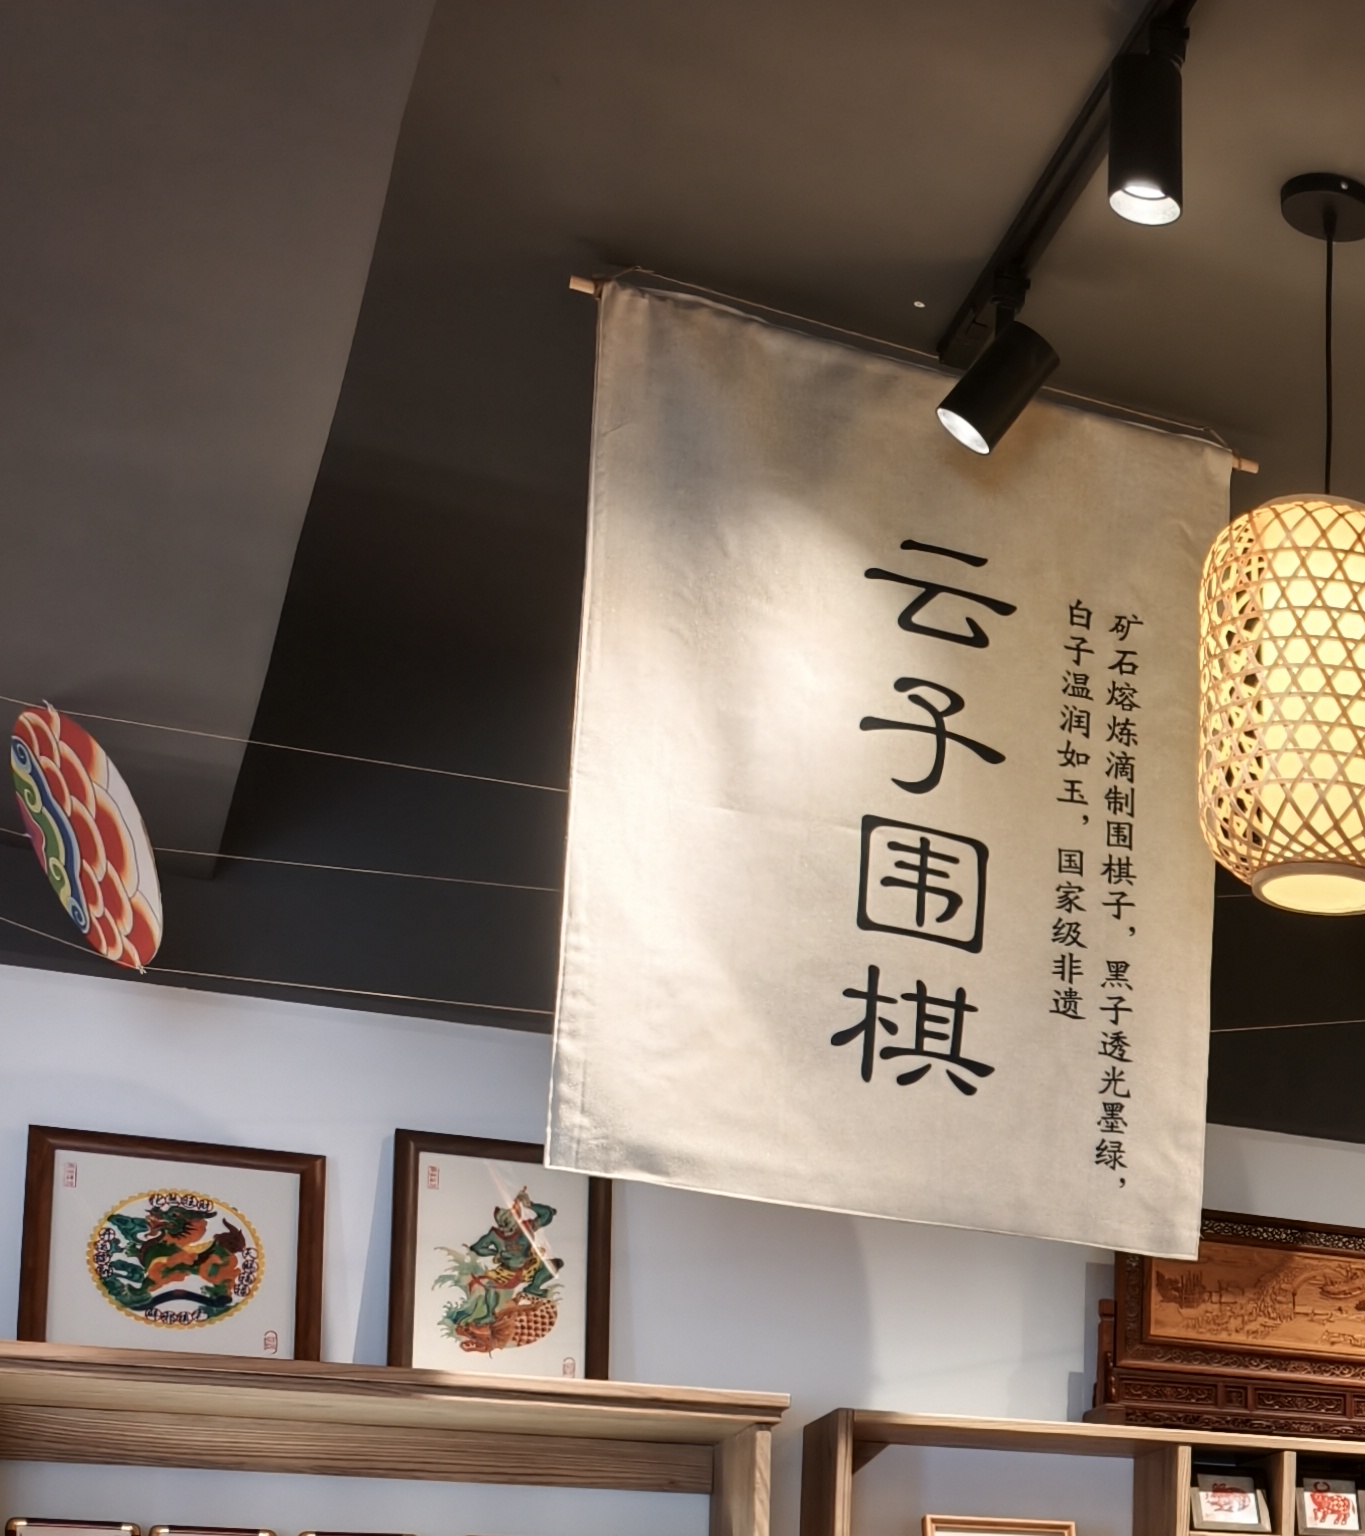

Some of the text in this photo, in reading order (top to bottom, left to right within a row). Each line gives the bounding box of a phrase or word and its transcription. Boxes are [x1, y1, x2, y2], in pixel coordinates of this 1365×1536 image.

[830, 539, 1017, 1095] 云子围棋
[1048, 600, 1094, 1021] 白子温润如玉，国家级非遗
